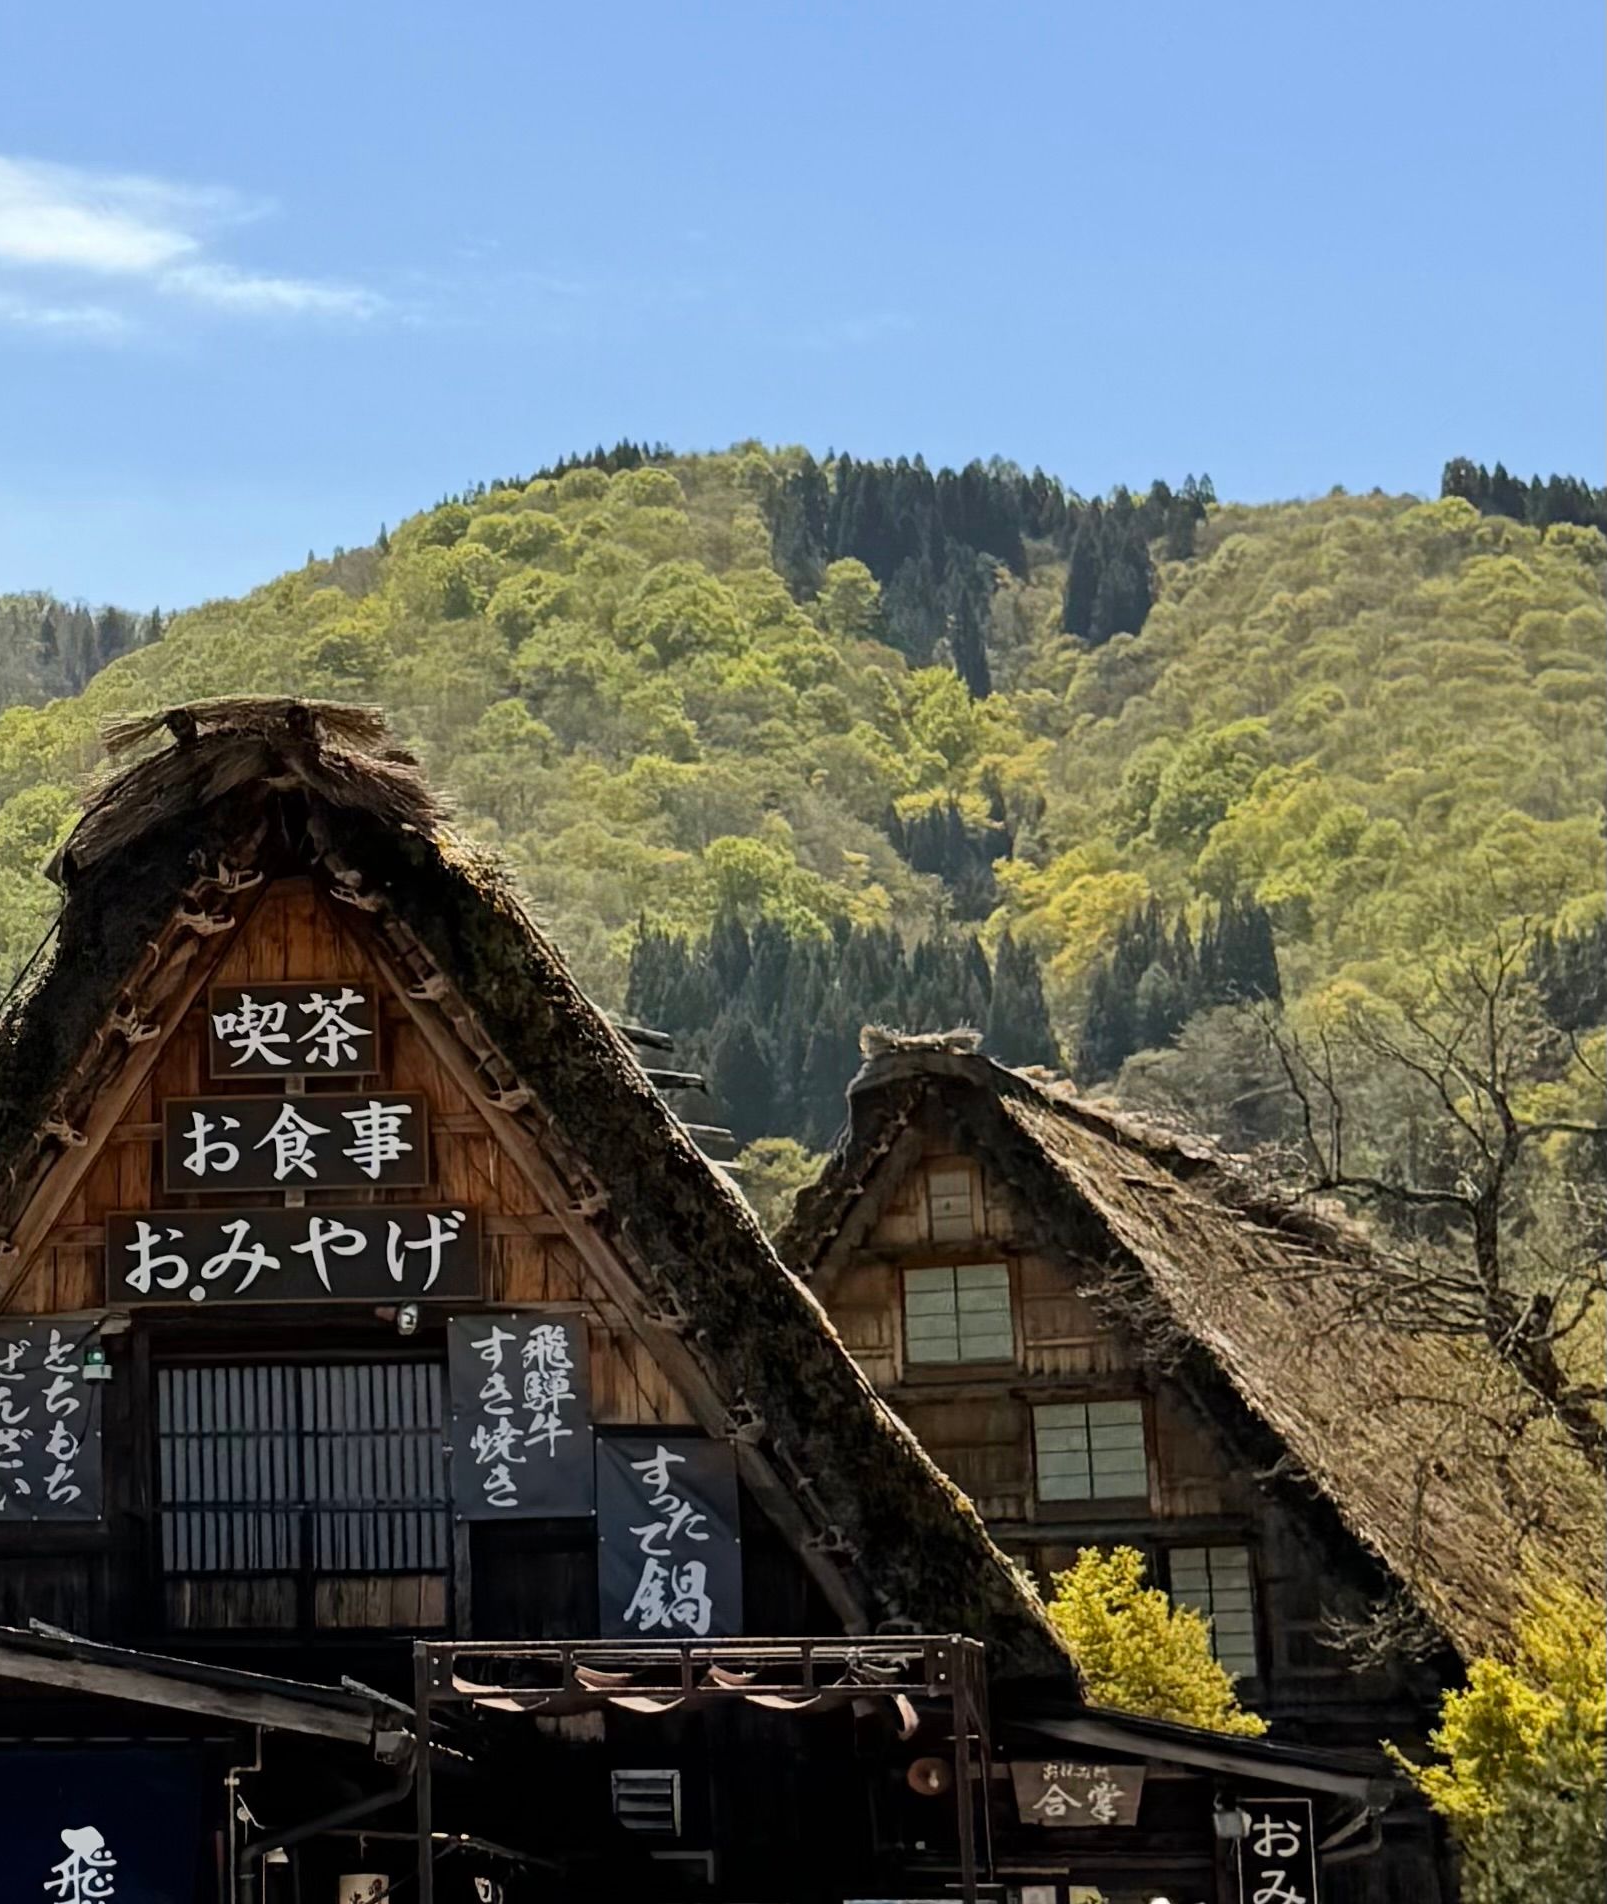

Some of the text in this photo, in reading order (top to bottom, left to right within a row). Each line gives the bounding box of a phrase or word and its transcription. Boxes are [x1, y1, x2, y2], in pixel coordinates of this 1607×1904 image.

[212, 987, 373, 1068] 喫茶
[182, 1100, 413, 1181] お食事
[125, 1210, 466, 1294] おみやげ
[41, 1329, 82, 1504] とちもち
[469, 1325, 527, 1507] すき焼き
[520, 1324, 576, 1457] 飛騨牛
